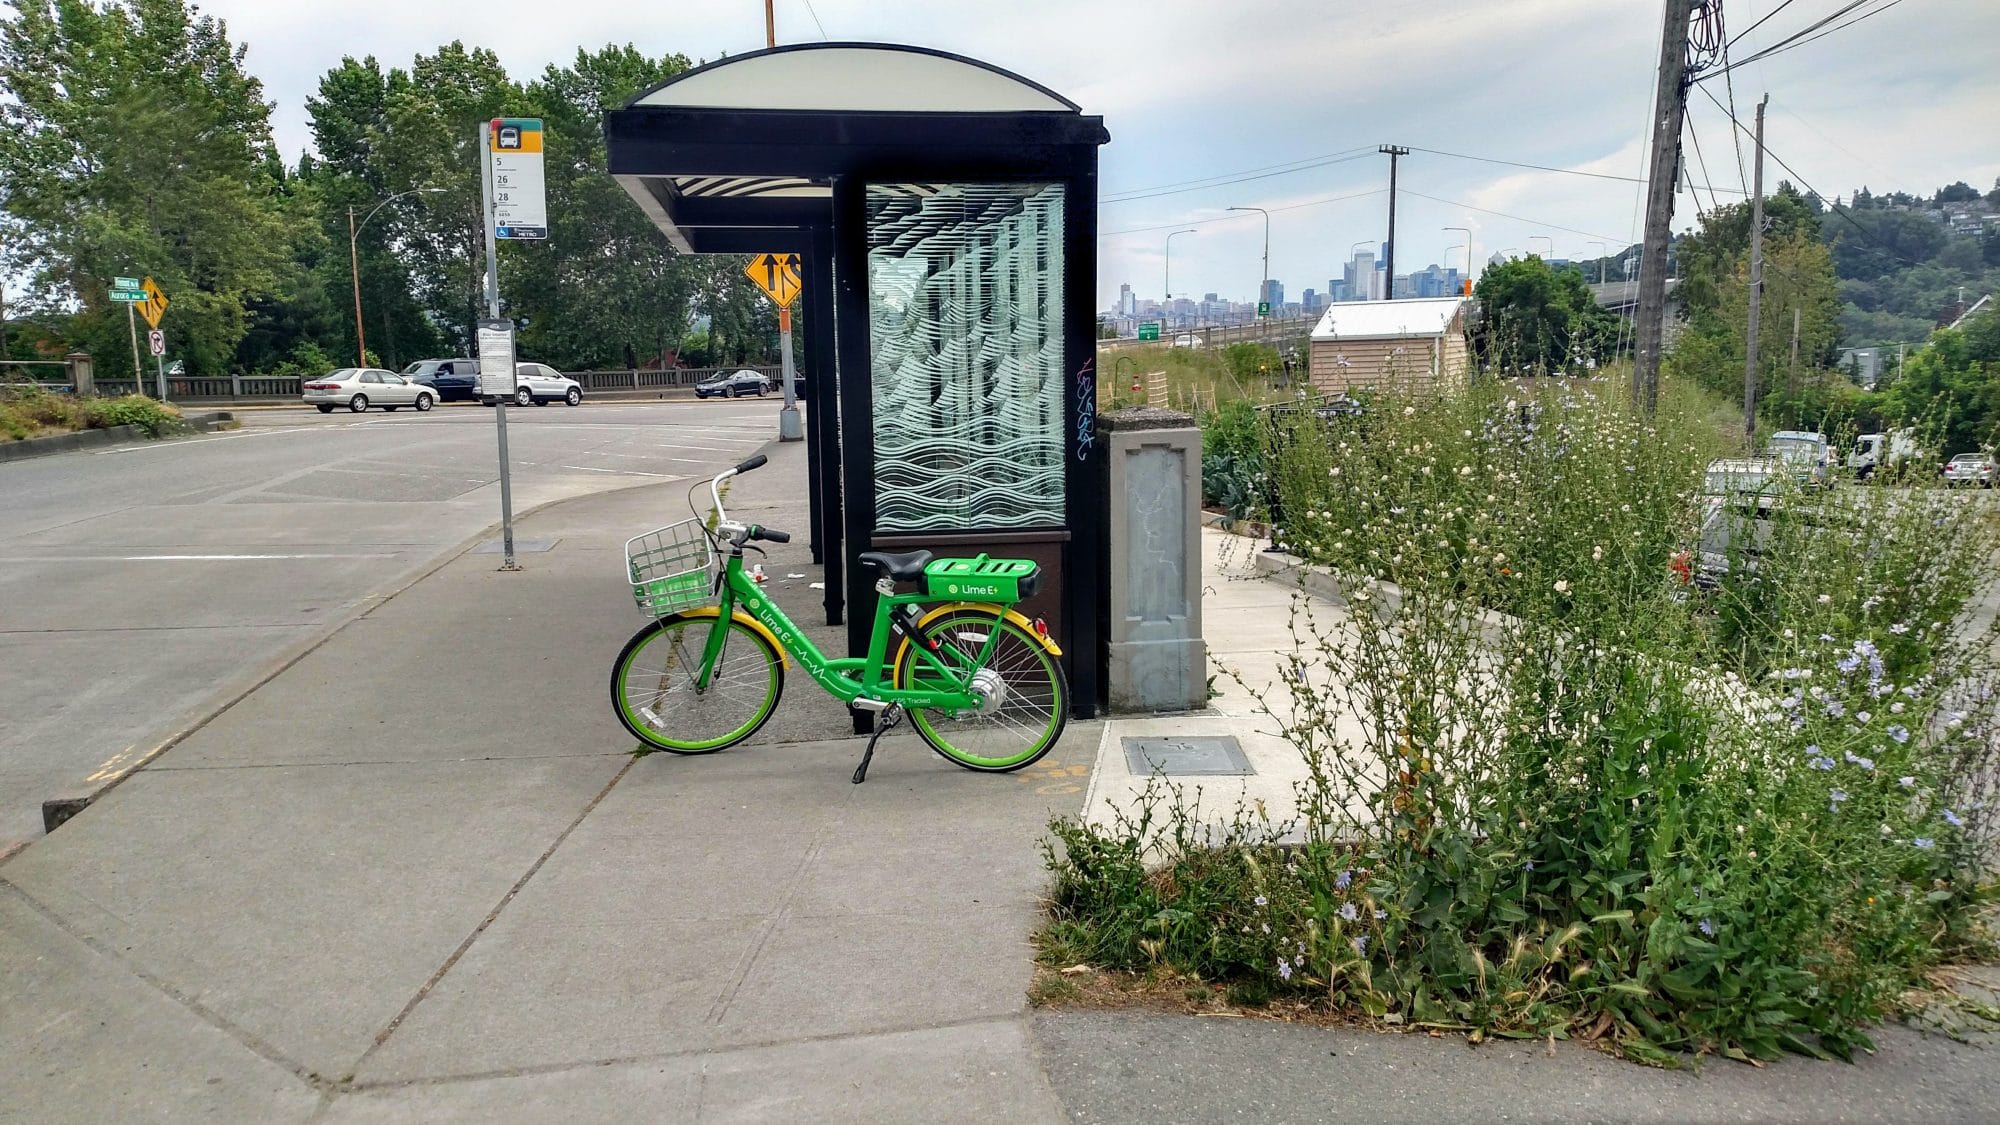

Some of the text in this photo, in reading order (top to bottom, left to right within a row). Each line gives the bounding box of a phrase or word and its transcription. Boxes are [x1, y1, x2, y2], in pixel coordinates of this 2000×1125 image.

[496, 157, 502, 165] 5
[497, 175, 508, 184] 26
[498, 193, 509, 201] 28
[111, 291, 130, 300] Aurora
[962, 584, 986, 594] Lime
[760, 609, 783, 634] Lime
